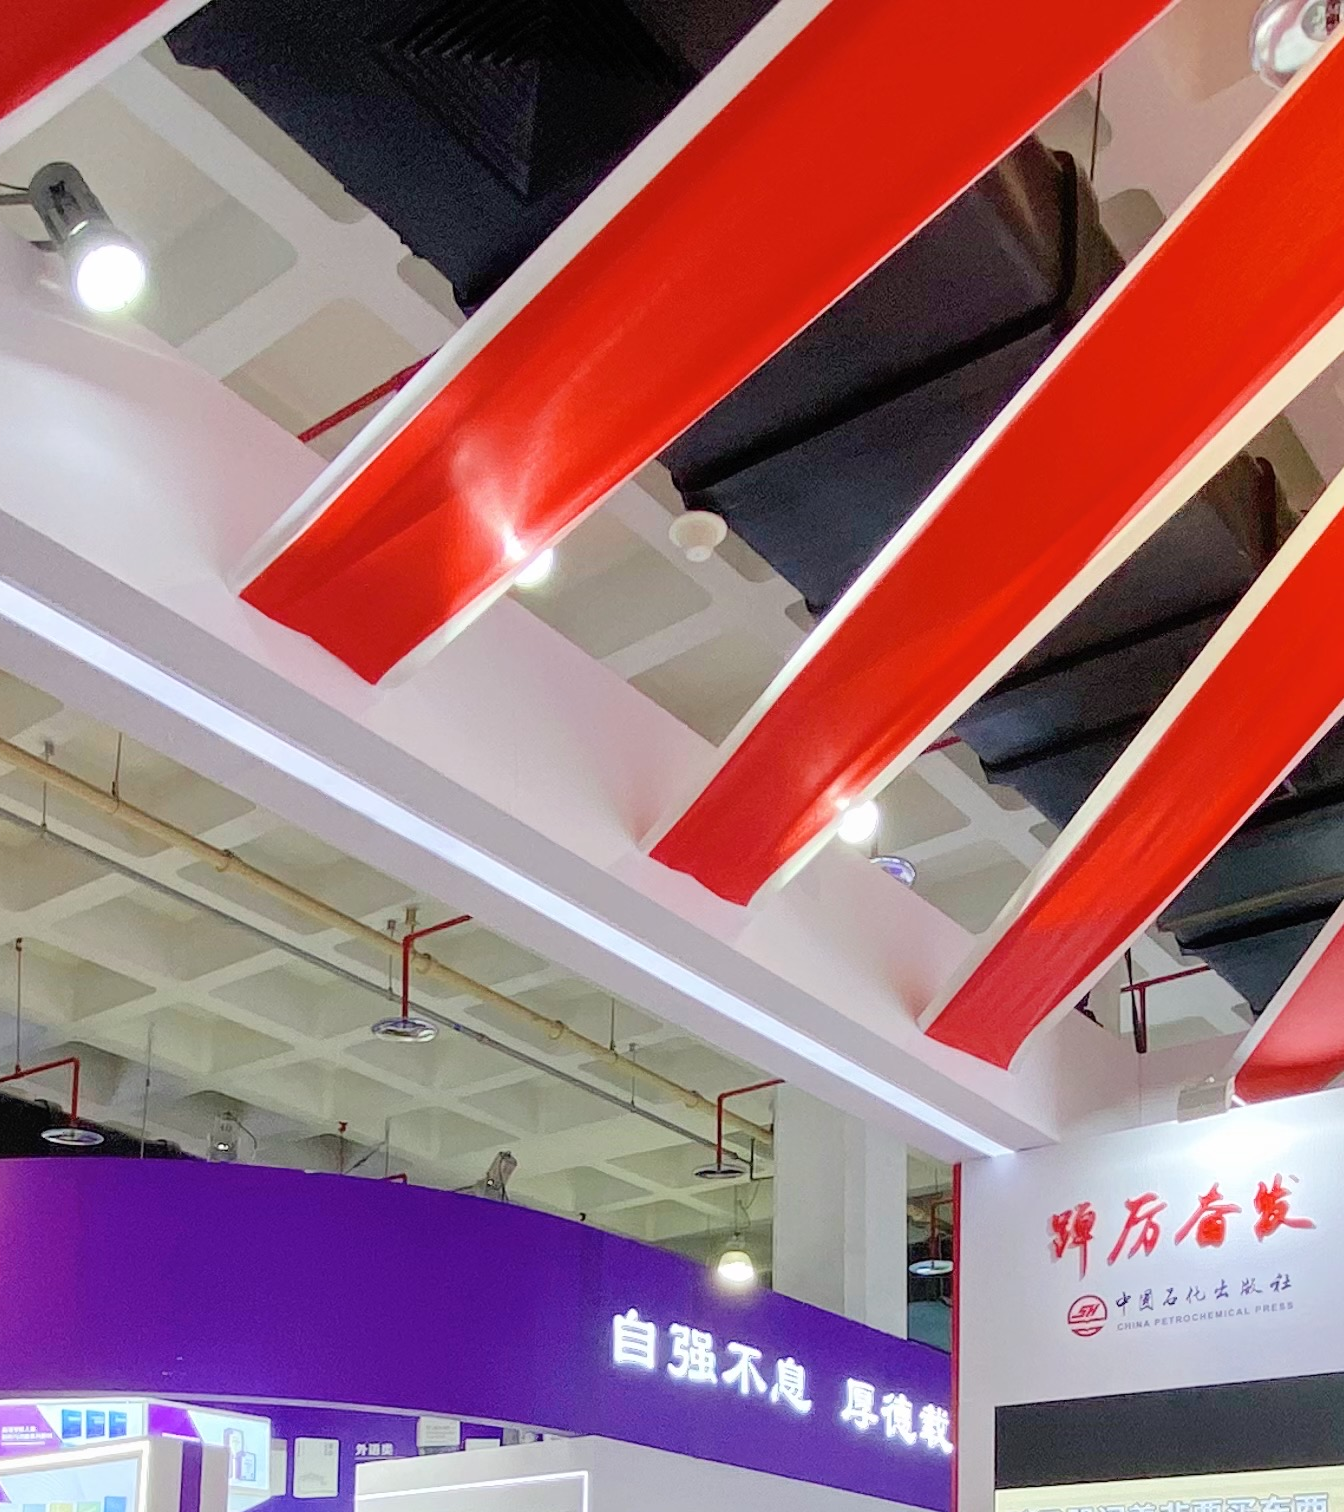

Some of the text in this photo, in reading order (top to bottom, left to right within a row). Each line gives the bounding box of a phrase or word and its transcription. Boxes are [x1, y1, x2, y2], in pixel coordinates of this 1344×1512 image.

[1116, 1301, 1295, 1332] CHINA PETROCHEMICAL PRESS
[612, 1308, 813, 1414] 自强不息
